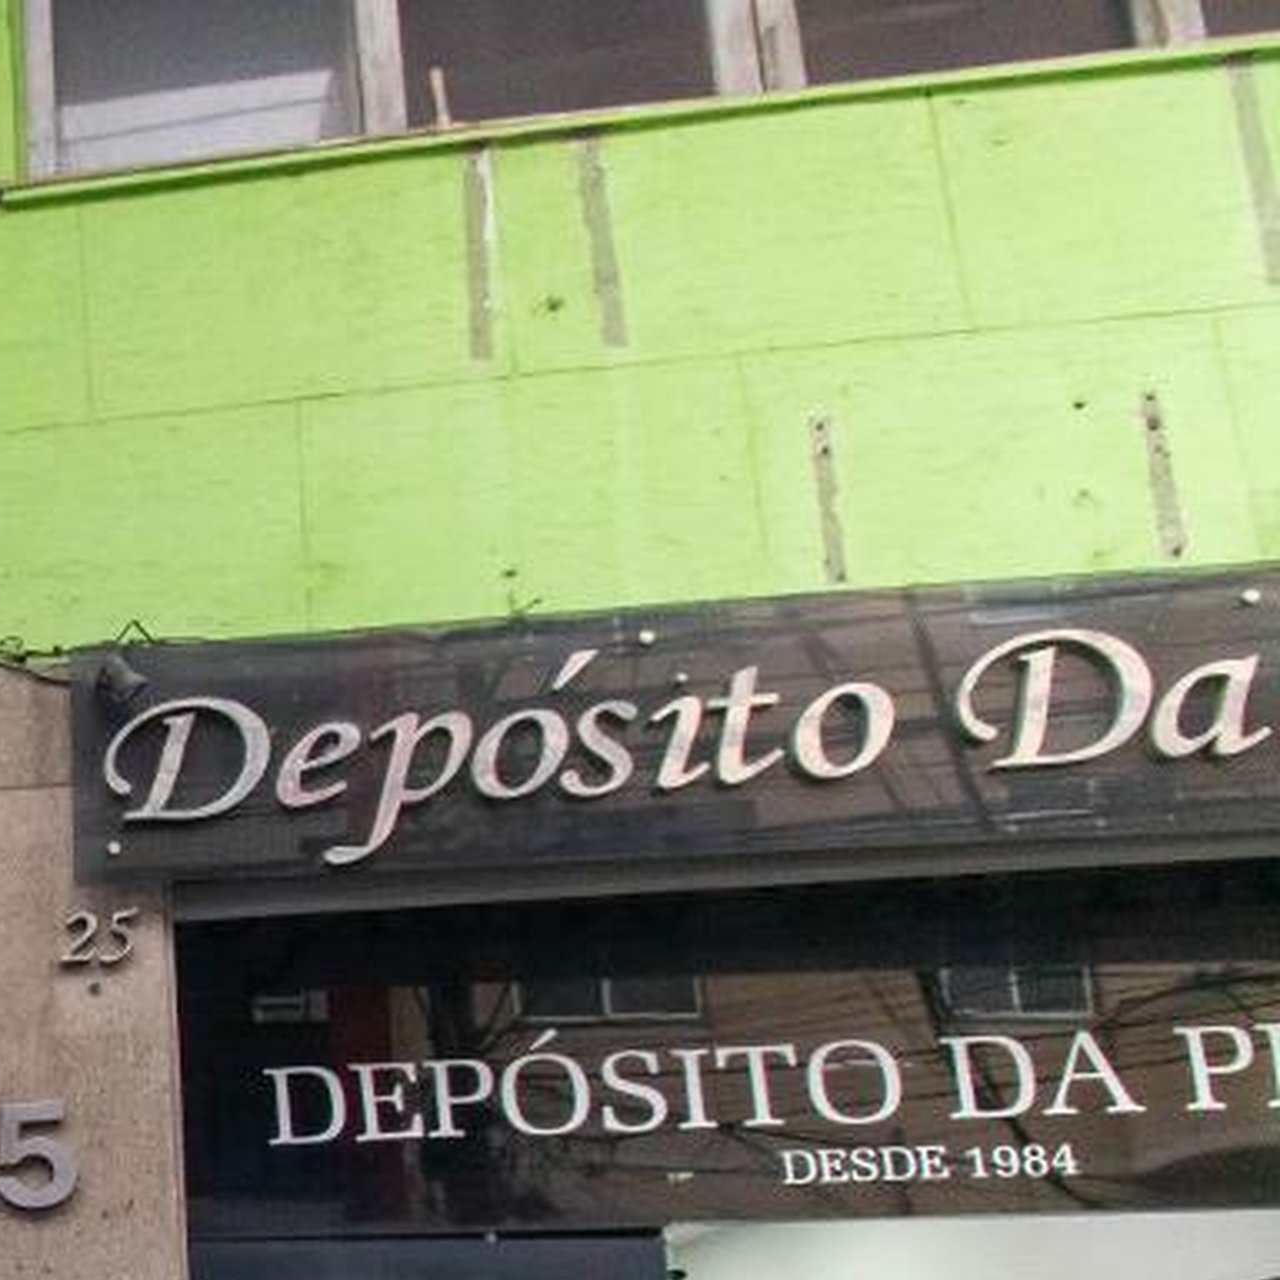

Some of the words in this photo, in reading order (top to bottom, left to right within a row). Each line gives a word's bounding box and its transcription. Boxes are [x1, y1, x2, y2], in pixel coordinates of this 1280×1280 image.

[104, 649, 896, 865] Depósito
[956, 628, 1273, 771] Da
[61, 907, 139, 966] 25
[262, 1029, 903, 1146] DEPÓSITO
[940, 1029, 1147, 1120] DA
[782, 1147, 951, 1186] DESDE
[966, 1143, 1081, 1179] 1984
